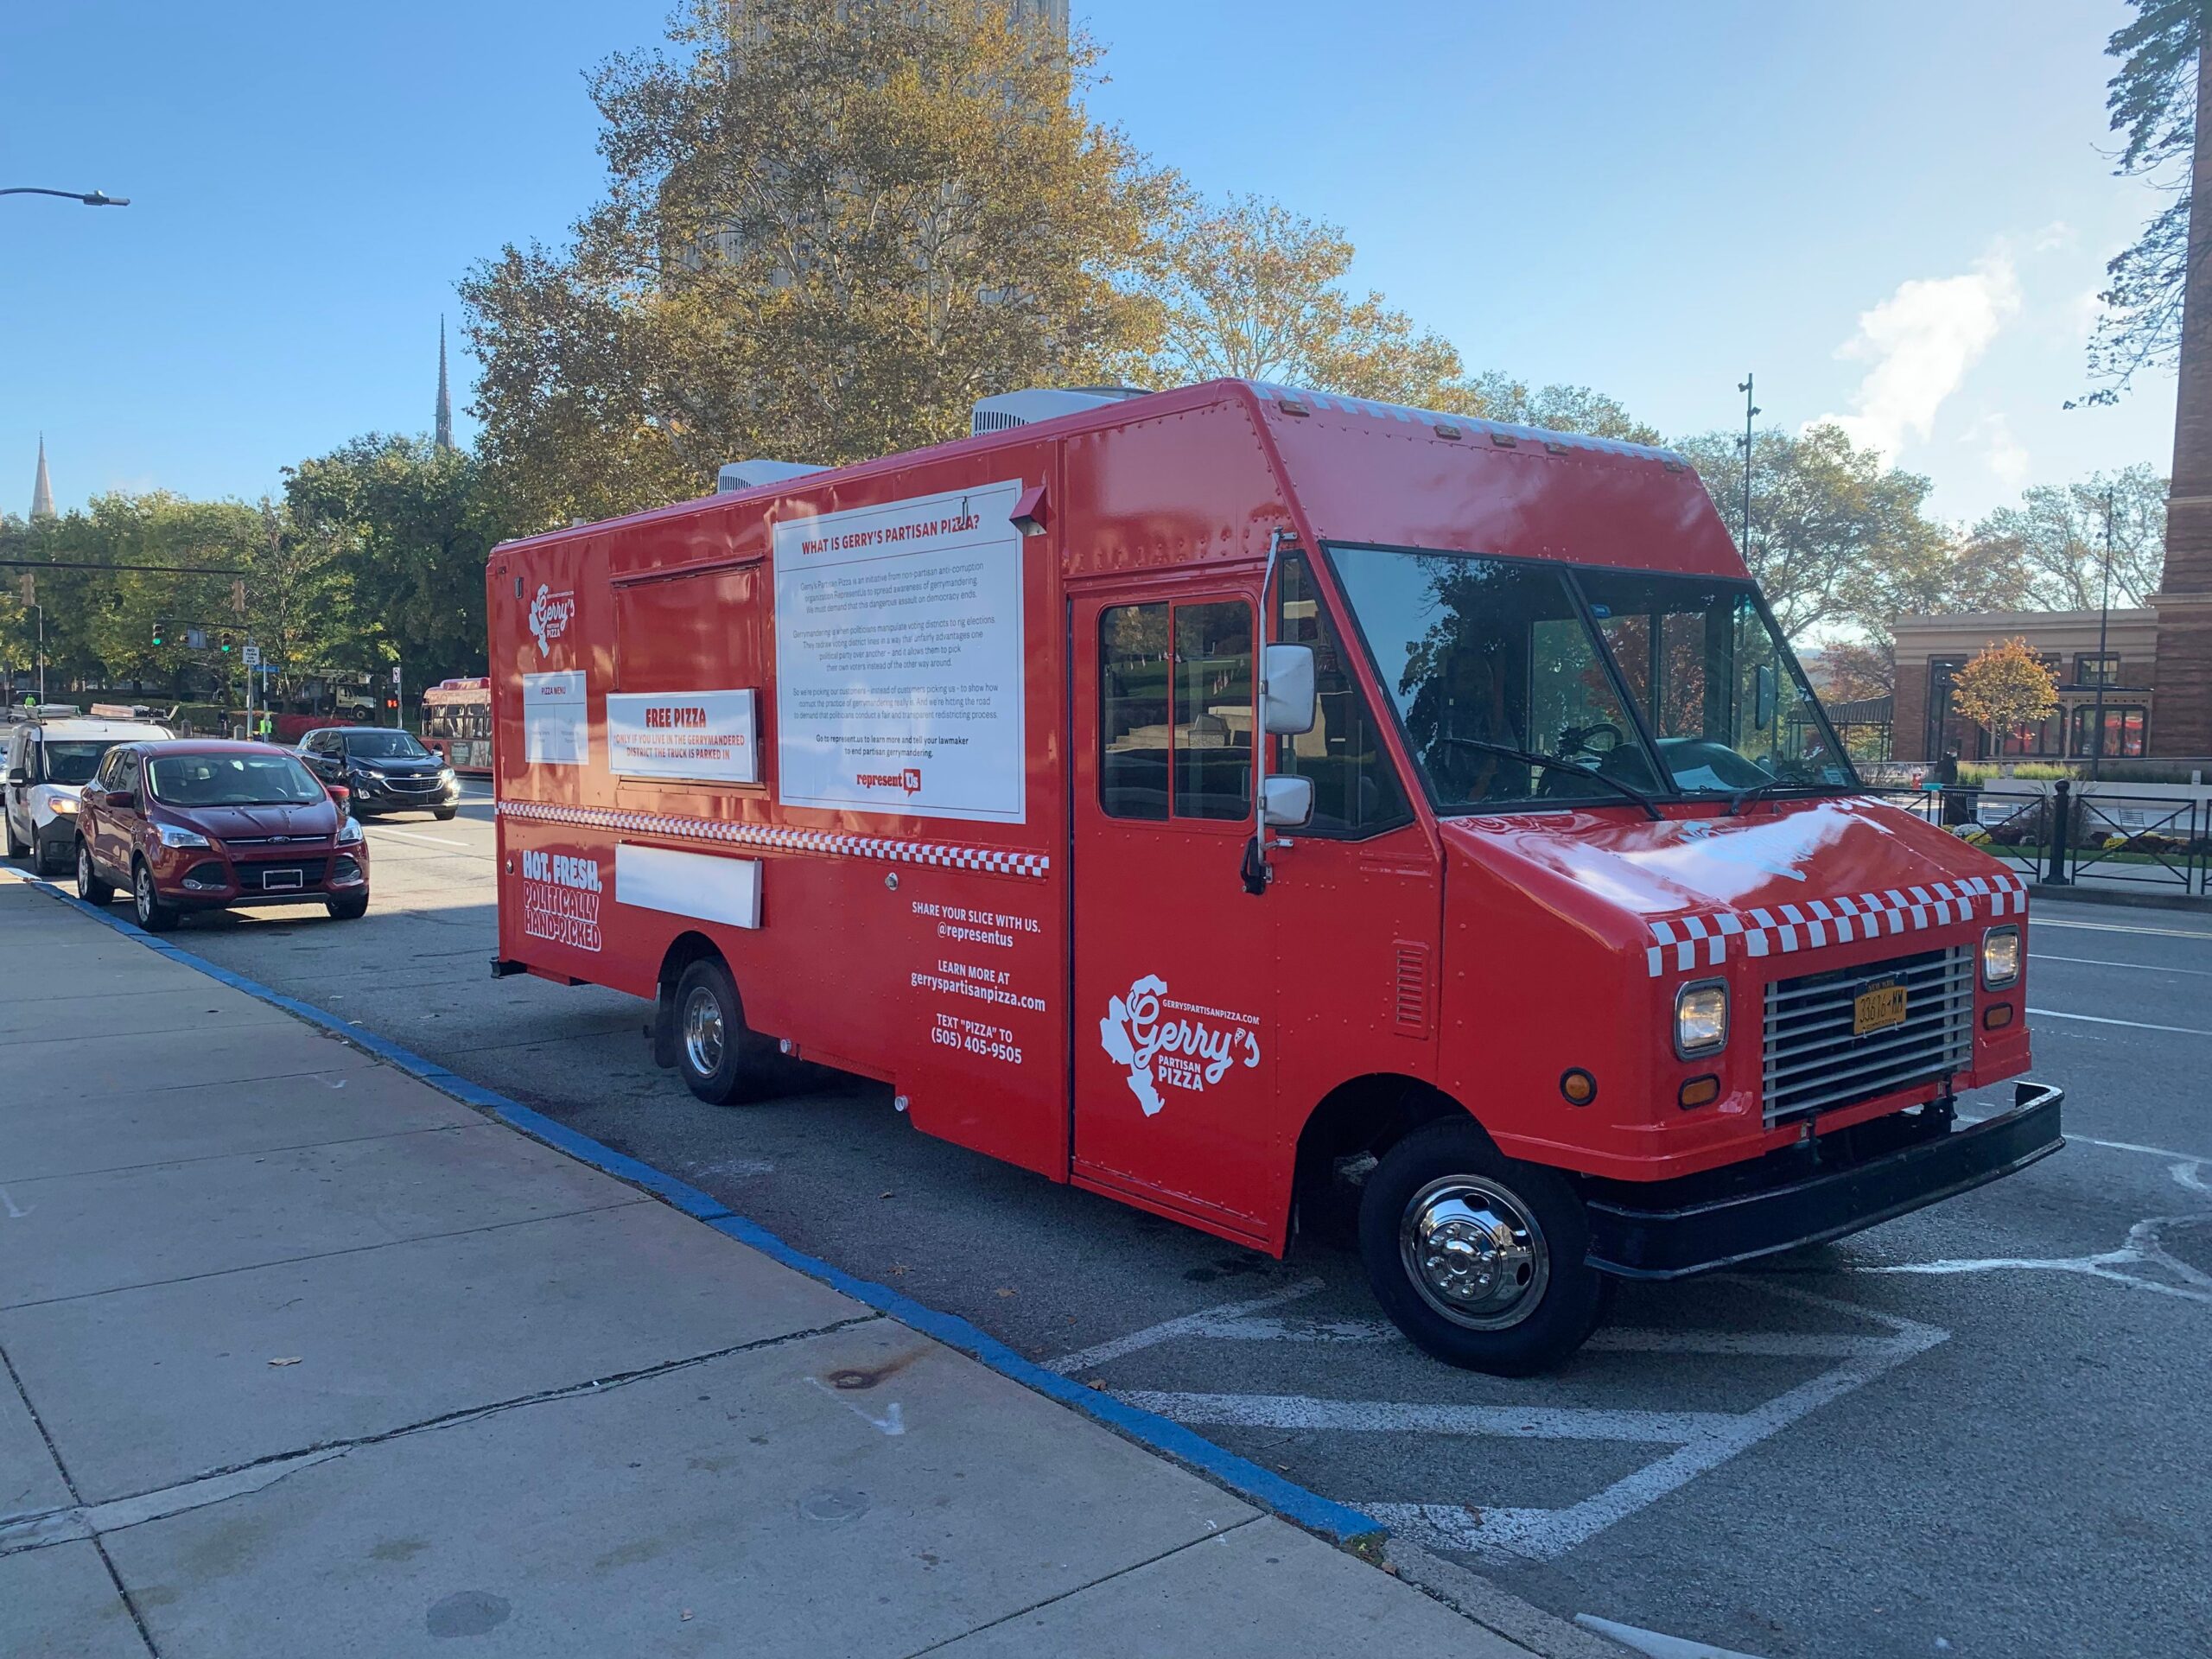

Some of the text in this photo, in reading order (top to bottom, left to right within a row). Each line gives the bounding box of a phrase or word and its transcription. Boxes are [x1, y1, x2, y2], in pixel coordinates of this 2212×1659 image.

[802, 514, 980, 555] WHAT IS GERRY'S PARTISAN PIZZA?
[865, 574, 887, 583] initiative
[901, 567, 938, 580] non-partisan
[938, 563, 984, 575] anti-corruption
[874, 585, 892, 596] spread
[893, 582, 922, 593] awareness
[923, 580, 930, 589] of
[868, 599, 897, 610] dangerous
[899, 595, 918, 605] assault
[926, 592, 959, 603] democracy
[547, 629, 560, 638] PIZZA
[849, 626, 876, 635] politicians
[877, 622, 906, 632] manipulate
[908, 620, 925, 630] voting
[925, 619, 949, 628] districts
[849, 638, 866, 646] district
[913, 632, 934, 643] unfairly
[936, 631, 969, 641] advantages
[839, 652, 852, 660] party
[948, 644, 961, 654] pick
[887, 660, 893, 669] of
[918, 660, 929, 669] way
[541, 686, 567, 695] PIZZA MENU
[891, 685, 896, 694] of
[898, 685, 925, 694] customers
[926, 684, 947, 695] picking
[968, 683, 984, 692] show
[944, 697, 963, 708] hitting
[976, 697, 991, 706] road
[645, 707, 706, 728] FREE PIZZA
[902, 711, 934, 721] transparent
[935, 710, 970, 721] redistricting
[632, 734, 638, 744] IF
[639, 734, 651, 744] YOU
[652, 734, 665, 744] LIVE
[666, 734, 673, 744] IN
[674, 734, 686, 745] THE
[688, 734, 745, 746] GERRYMANDERED
[816, 734, 823, 742] Go
[830, 735, 863, 744] represent.us
[924, 737, 938, 746] your
[938, 735, 969, 745] lawmaker
[627, 747, 730, 760] DISTRICT THE TRUCK IS PARKED IN
[862, 747, 886, 756] partisan
[886, 748, 933, 759] gerrymandering.
[523, 850, 603, 893] HOT, FRESH,
[524, 881, 600, 924] POLITICALLY
[912, 901, 1041, 933] SHARE YOUR SLICE WITH US.
[524, 909, 602, 952] HAND-PICKED
[938, 921, 1014, 947] @representus
[938, 959, 1010, 985] LEARN MORE AT
[911, 972, 1046, 1012] gerryspartisanpizza.com
[1162, 999, 1260, 1026] GERRYSPARTISANPIZZA.COM
[937, 1013, 1013, 1043] TEXT "PIZZA" TO
[1125, 990, 1261, 1084] Gerry's
[931, 1027, 1022, 1065] (505) 405-9505
[1158, 1054, 1201, 1073] PARTISAN
[1158, 1065, 1204, 1091] PIZZA
